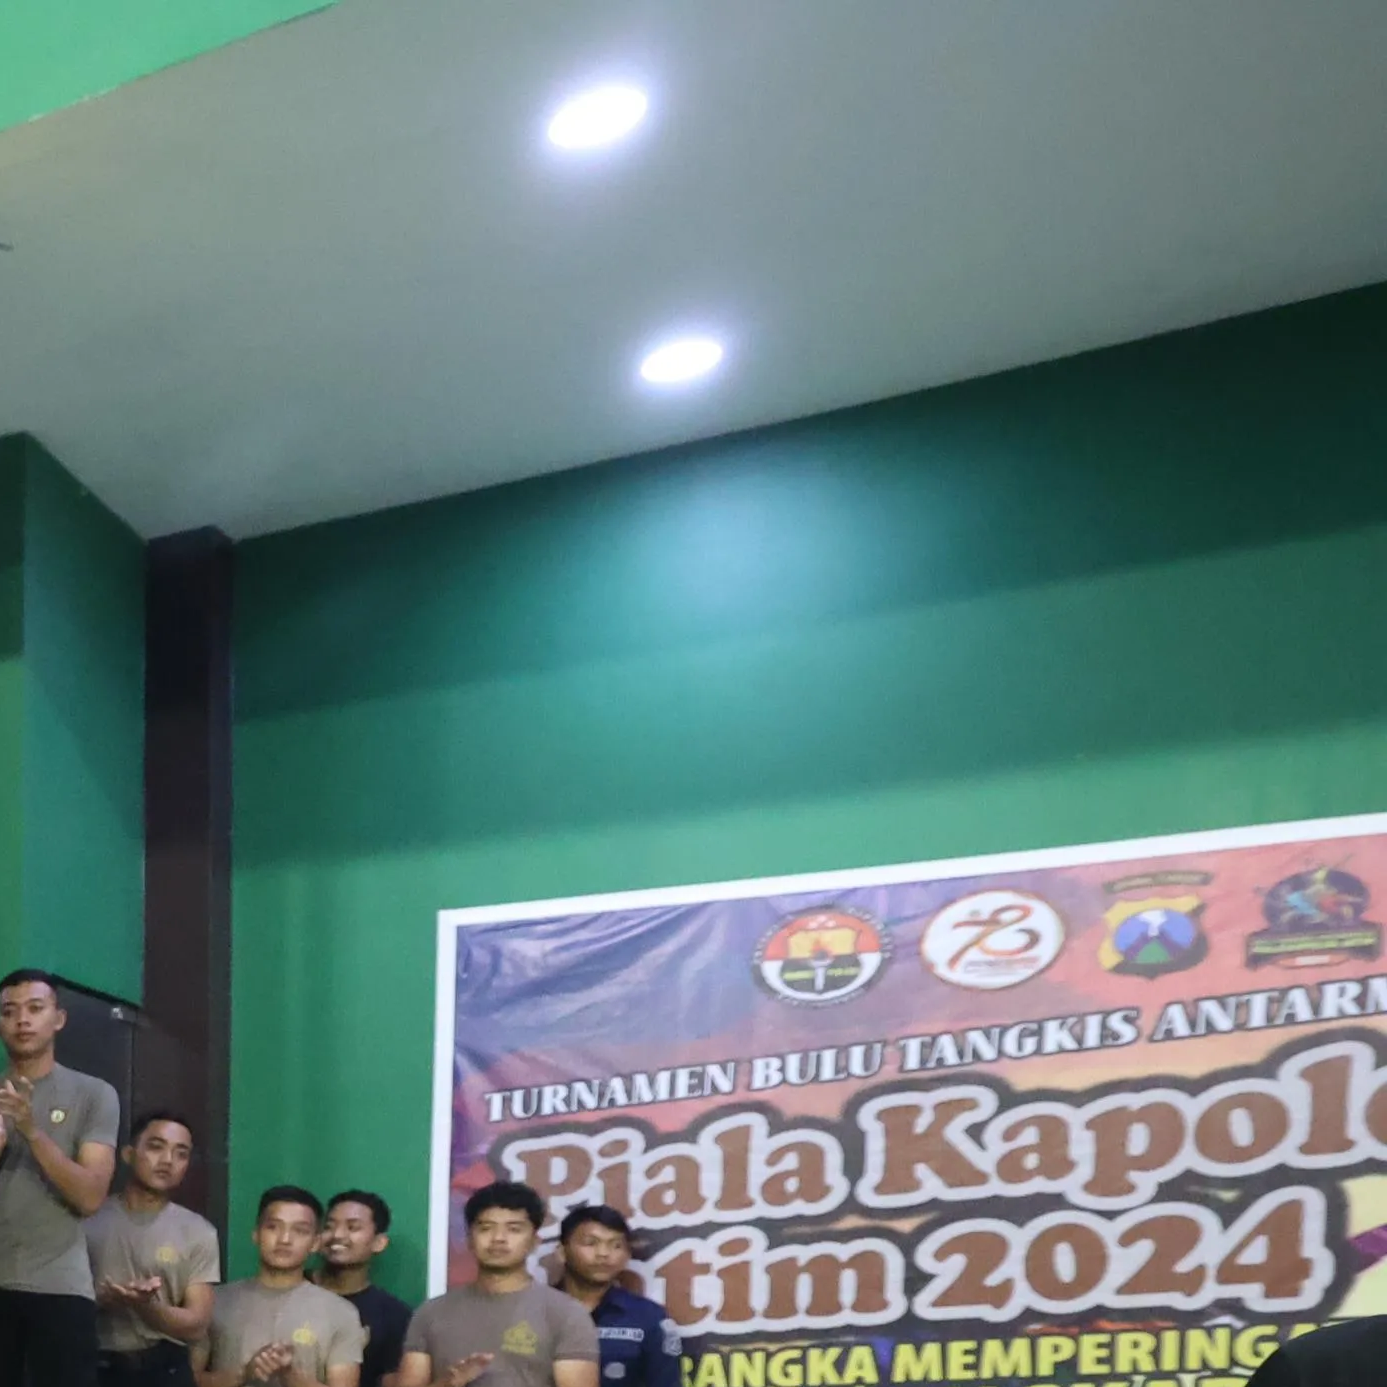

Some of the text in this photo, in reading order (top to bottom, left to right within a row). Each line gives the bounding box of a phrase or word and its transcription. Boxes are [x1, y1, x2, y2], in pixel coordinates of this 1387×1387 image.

[484, 1059, 737, 1124] TURNAMEN
[749, 1040, 885, 1093] BULU
[899, 1008, 1140, 1072] TANGKIS
[505, 1114, 847, 1240] Piala
[539, 1188, 1333, 1334] tim 2024
